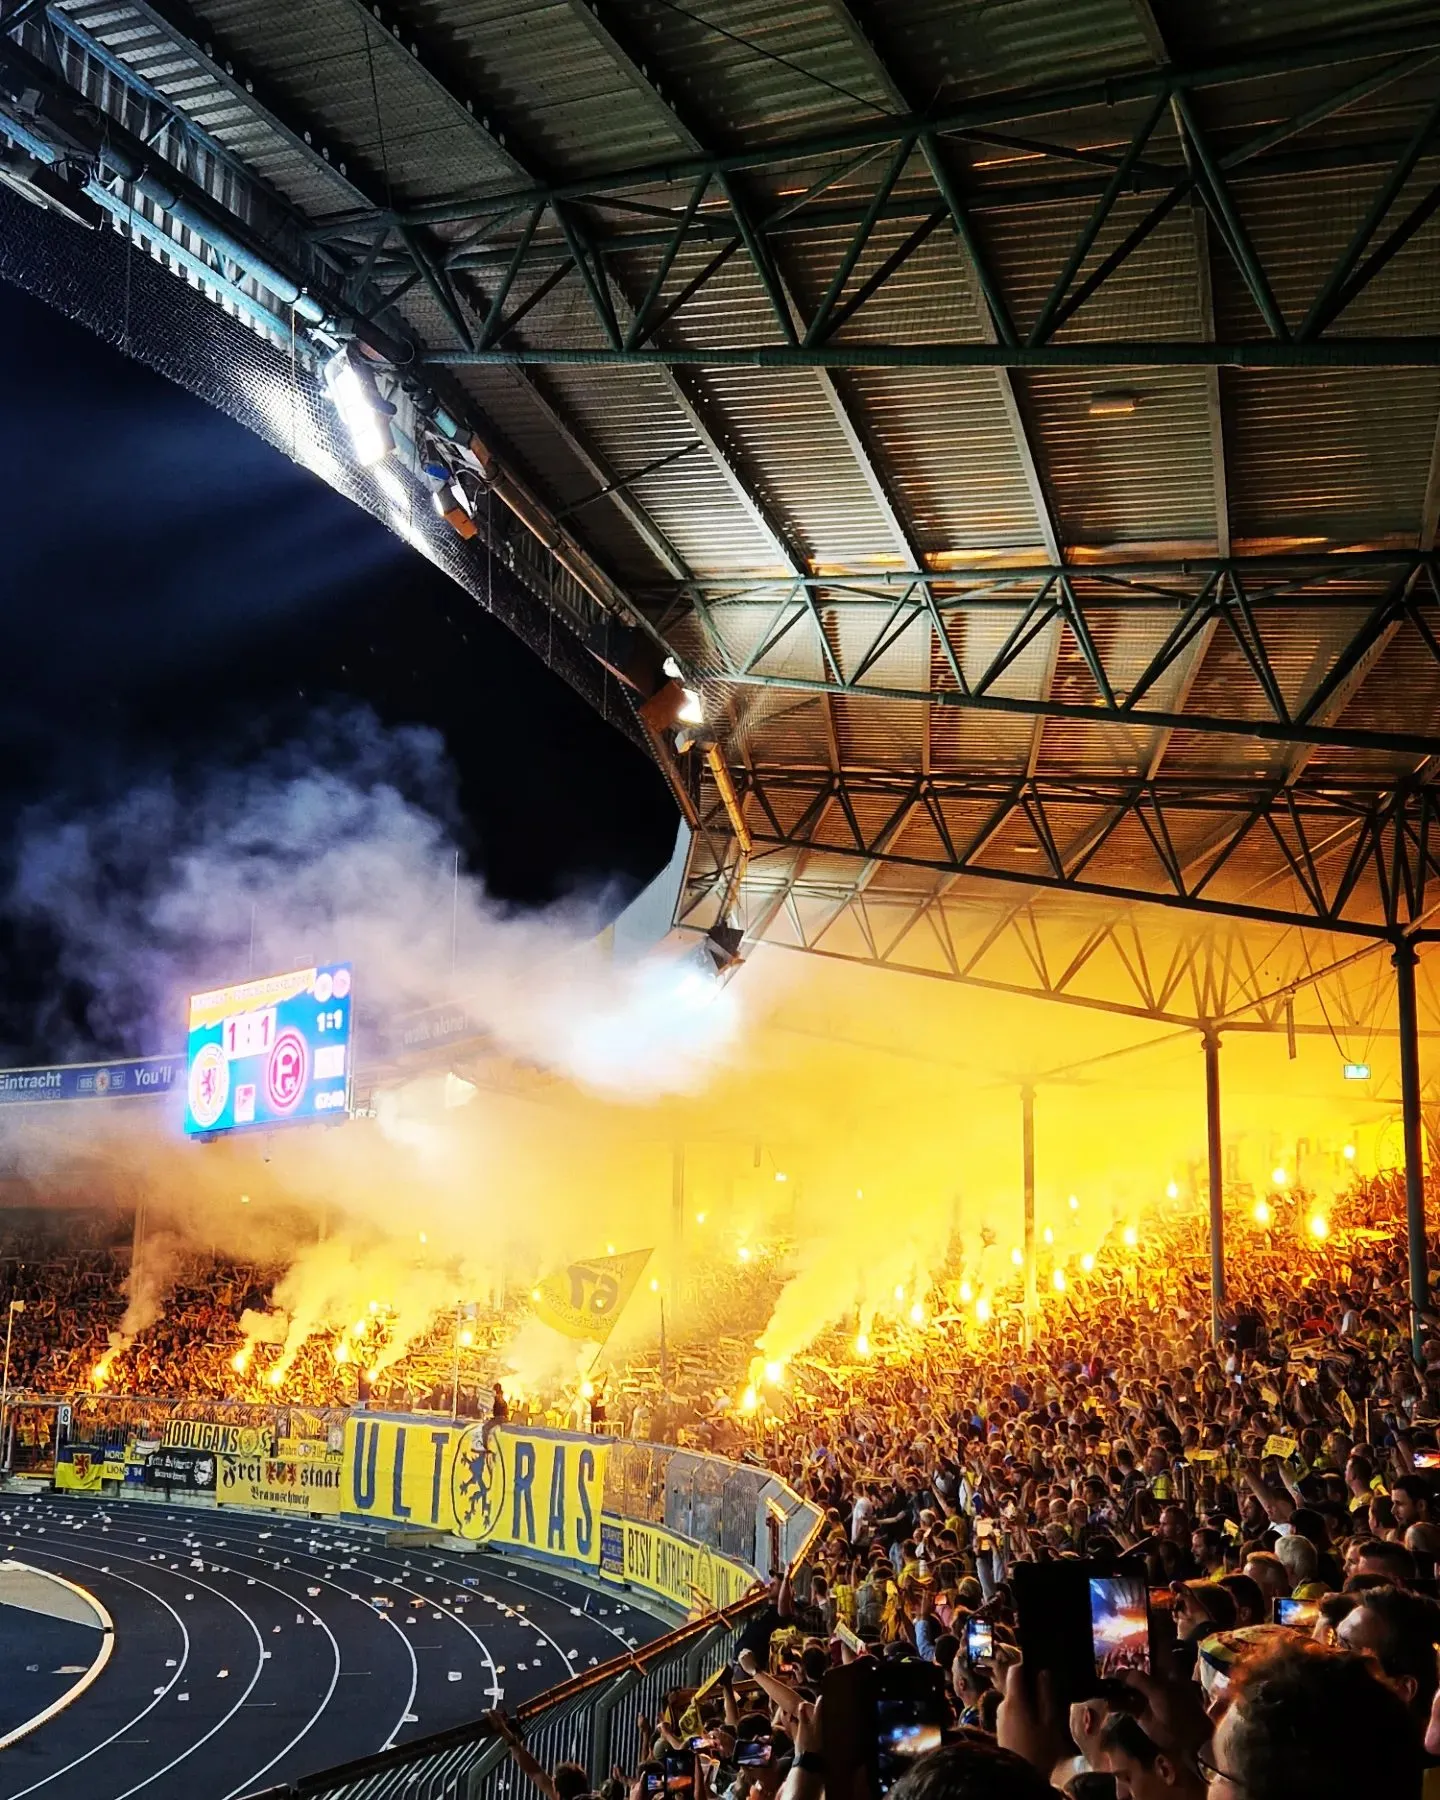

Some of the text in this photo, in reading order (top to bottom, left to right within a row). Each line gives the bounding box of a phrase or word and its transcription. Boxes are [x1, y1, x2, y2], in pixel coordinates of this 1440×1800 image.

[134, 1065, 172, 1086] You'll
[62, 1408, 69, 1423] 8
[164, 1420, 240, 1453] HOOLIGANS
[105, 1449, 124, 1460] NORD
[106, 1465, 129, 1477] LIONS
[628, 1527, 652, 1580] BTSV
[656, 1537, 694, 1602] EINTRACHT
